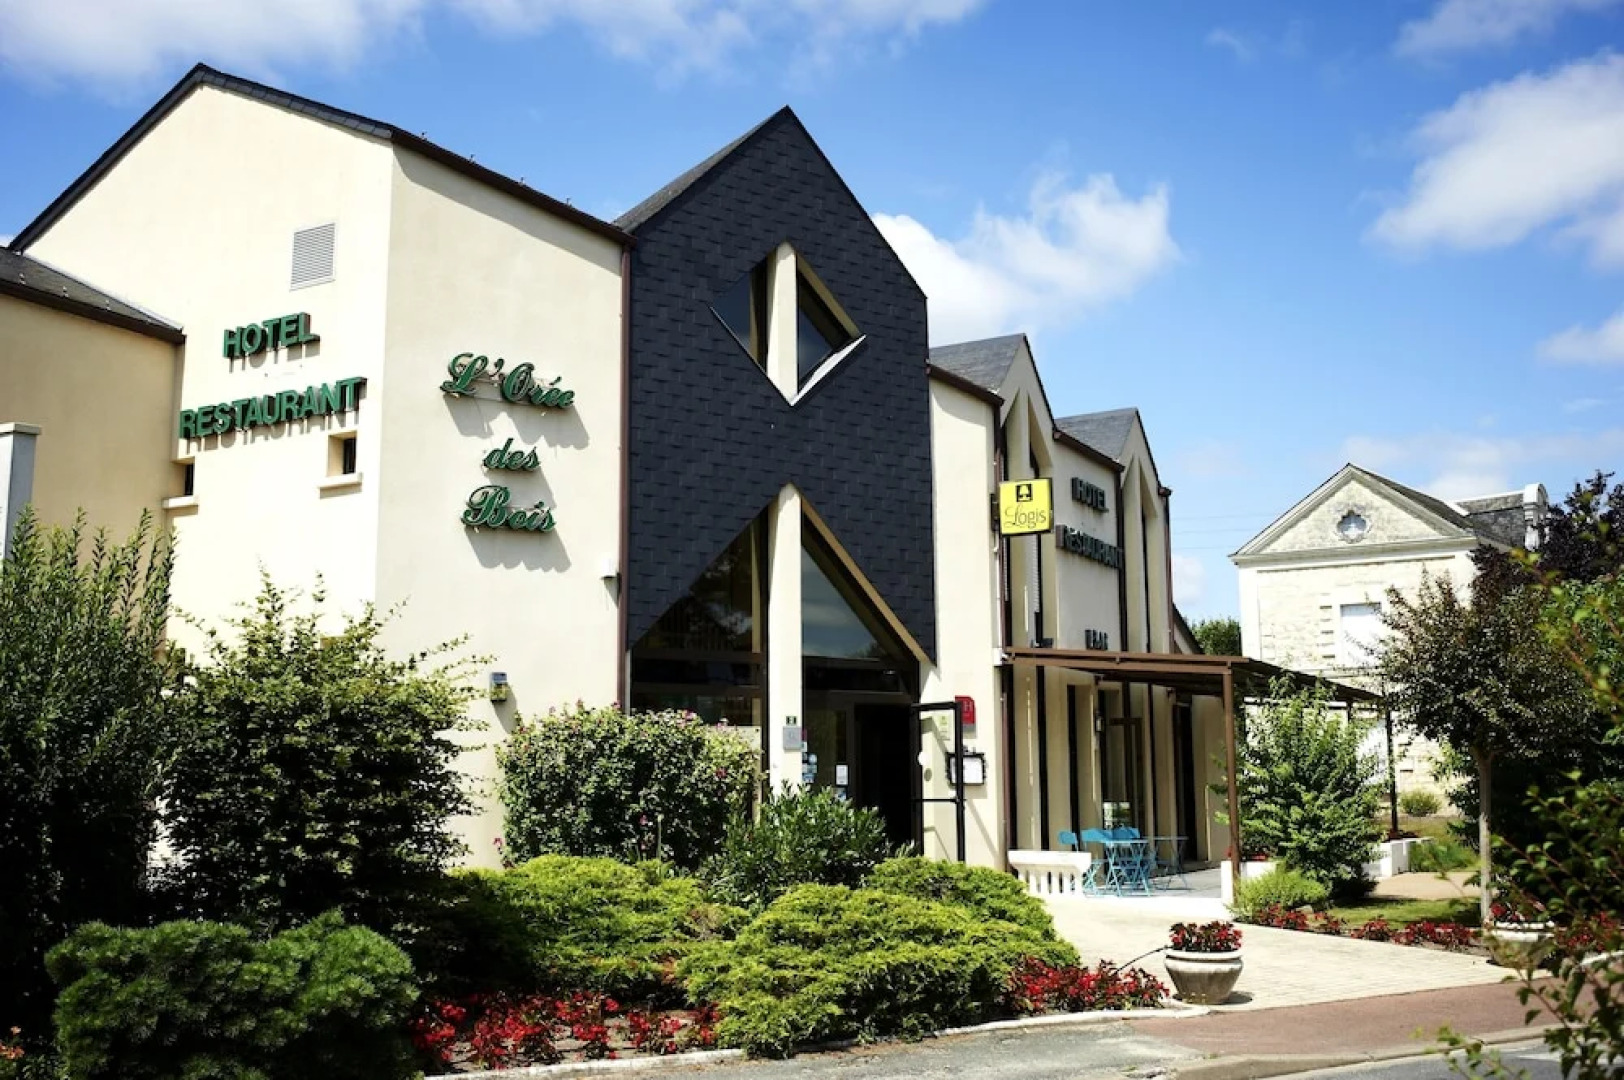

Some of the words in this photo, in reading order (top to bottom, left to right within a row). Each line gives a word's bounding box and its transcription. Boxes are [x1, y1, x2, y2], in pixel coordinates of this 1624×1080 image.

[222, 312, 320, 358] HOTEL
[440, 352, 575, 408] L'Orée
[178, 376, 367, 438] RESTAURANT
[483, 437, 540, 471] des
[460, 485, 555, 533] Bois
[1004, 503, 1046, 529] Logis
